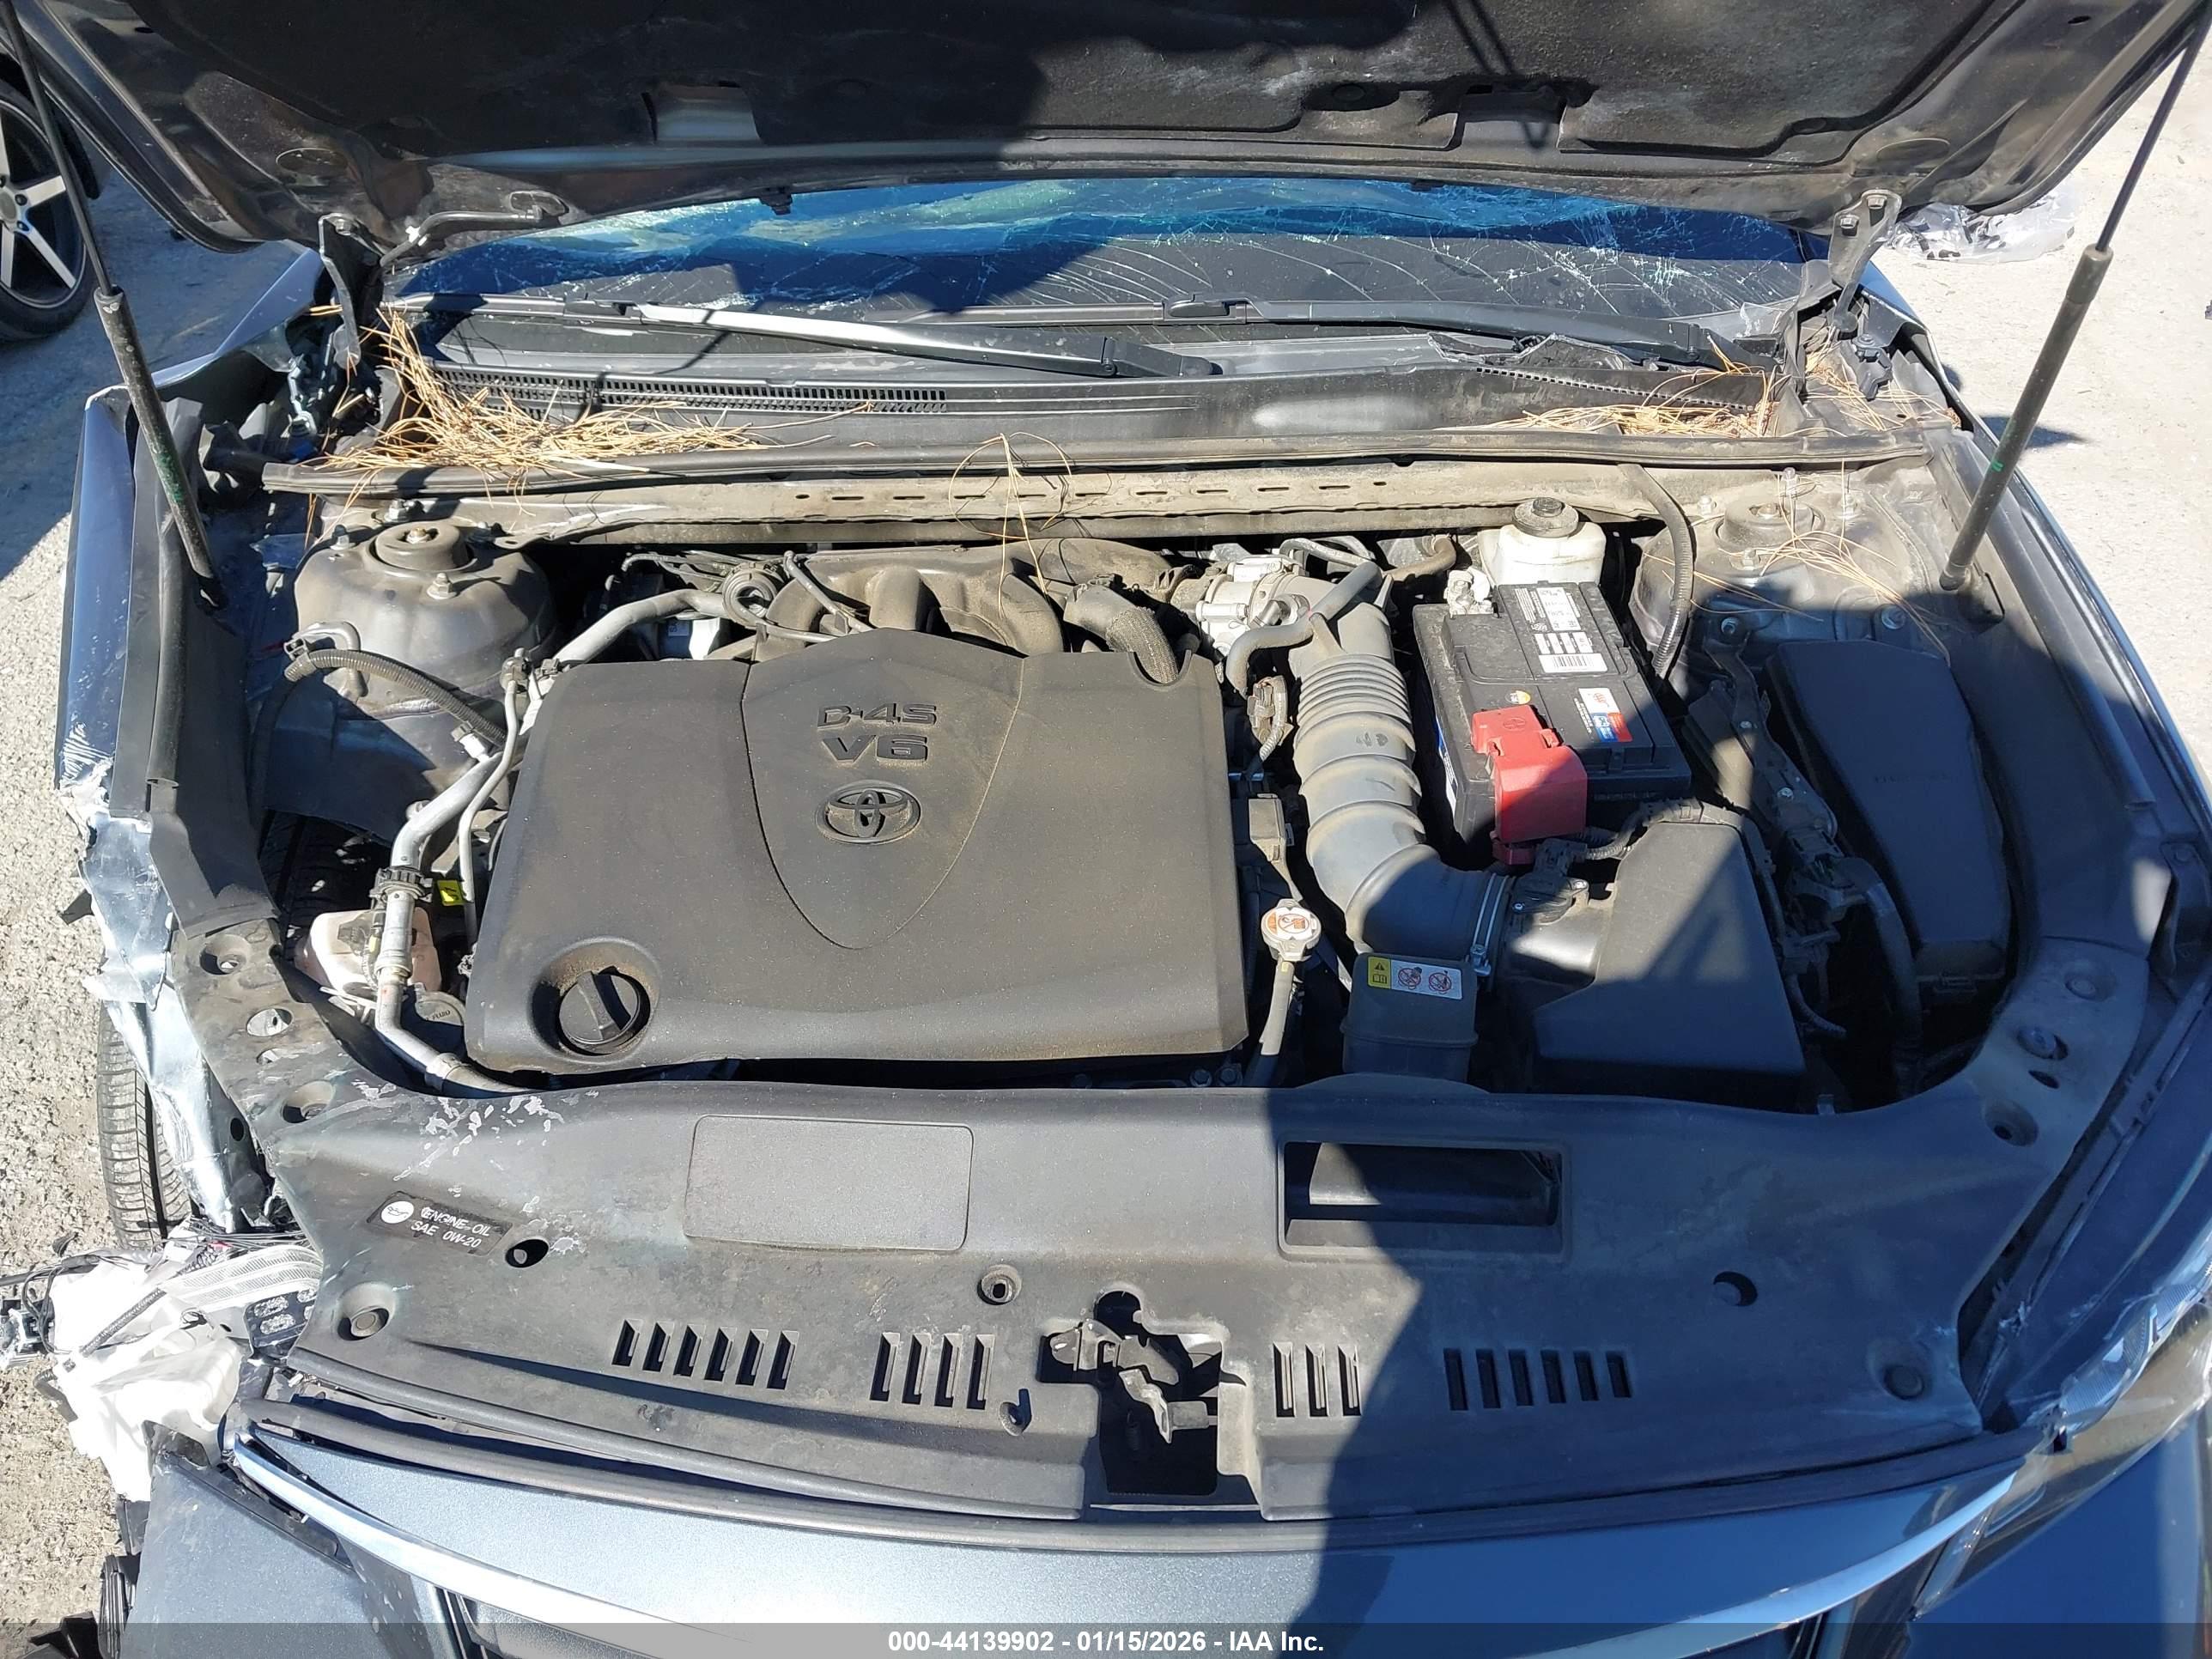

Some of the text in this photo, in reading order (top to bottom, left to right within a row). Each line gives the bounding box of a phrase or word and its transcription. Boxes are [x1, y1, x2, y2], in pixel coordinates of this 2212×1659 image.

[817, 702, 937, 729] D-4S
[821, 733, 929, 763] V6
[410, 1220, 483, 1248] SAE 0W-20
[421, 1206, 491, 1237] ENGINE OIL
